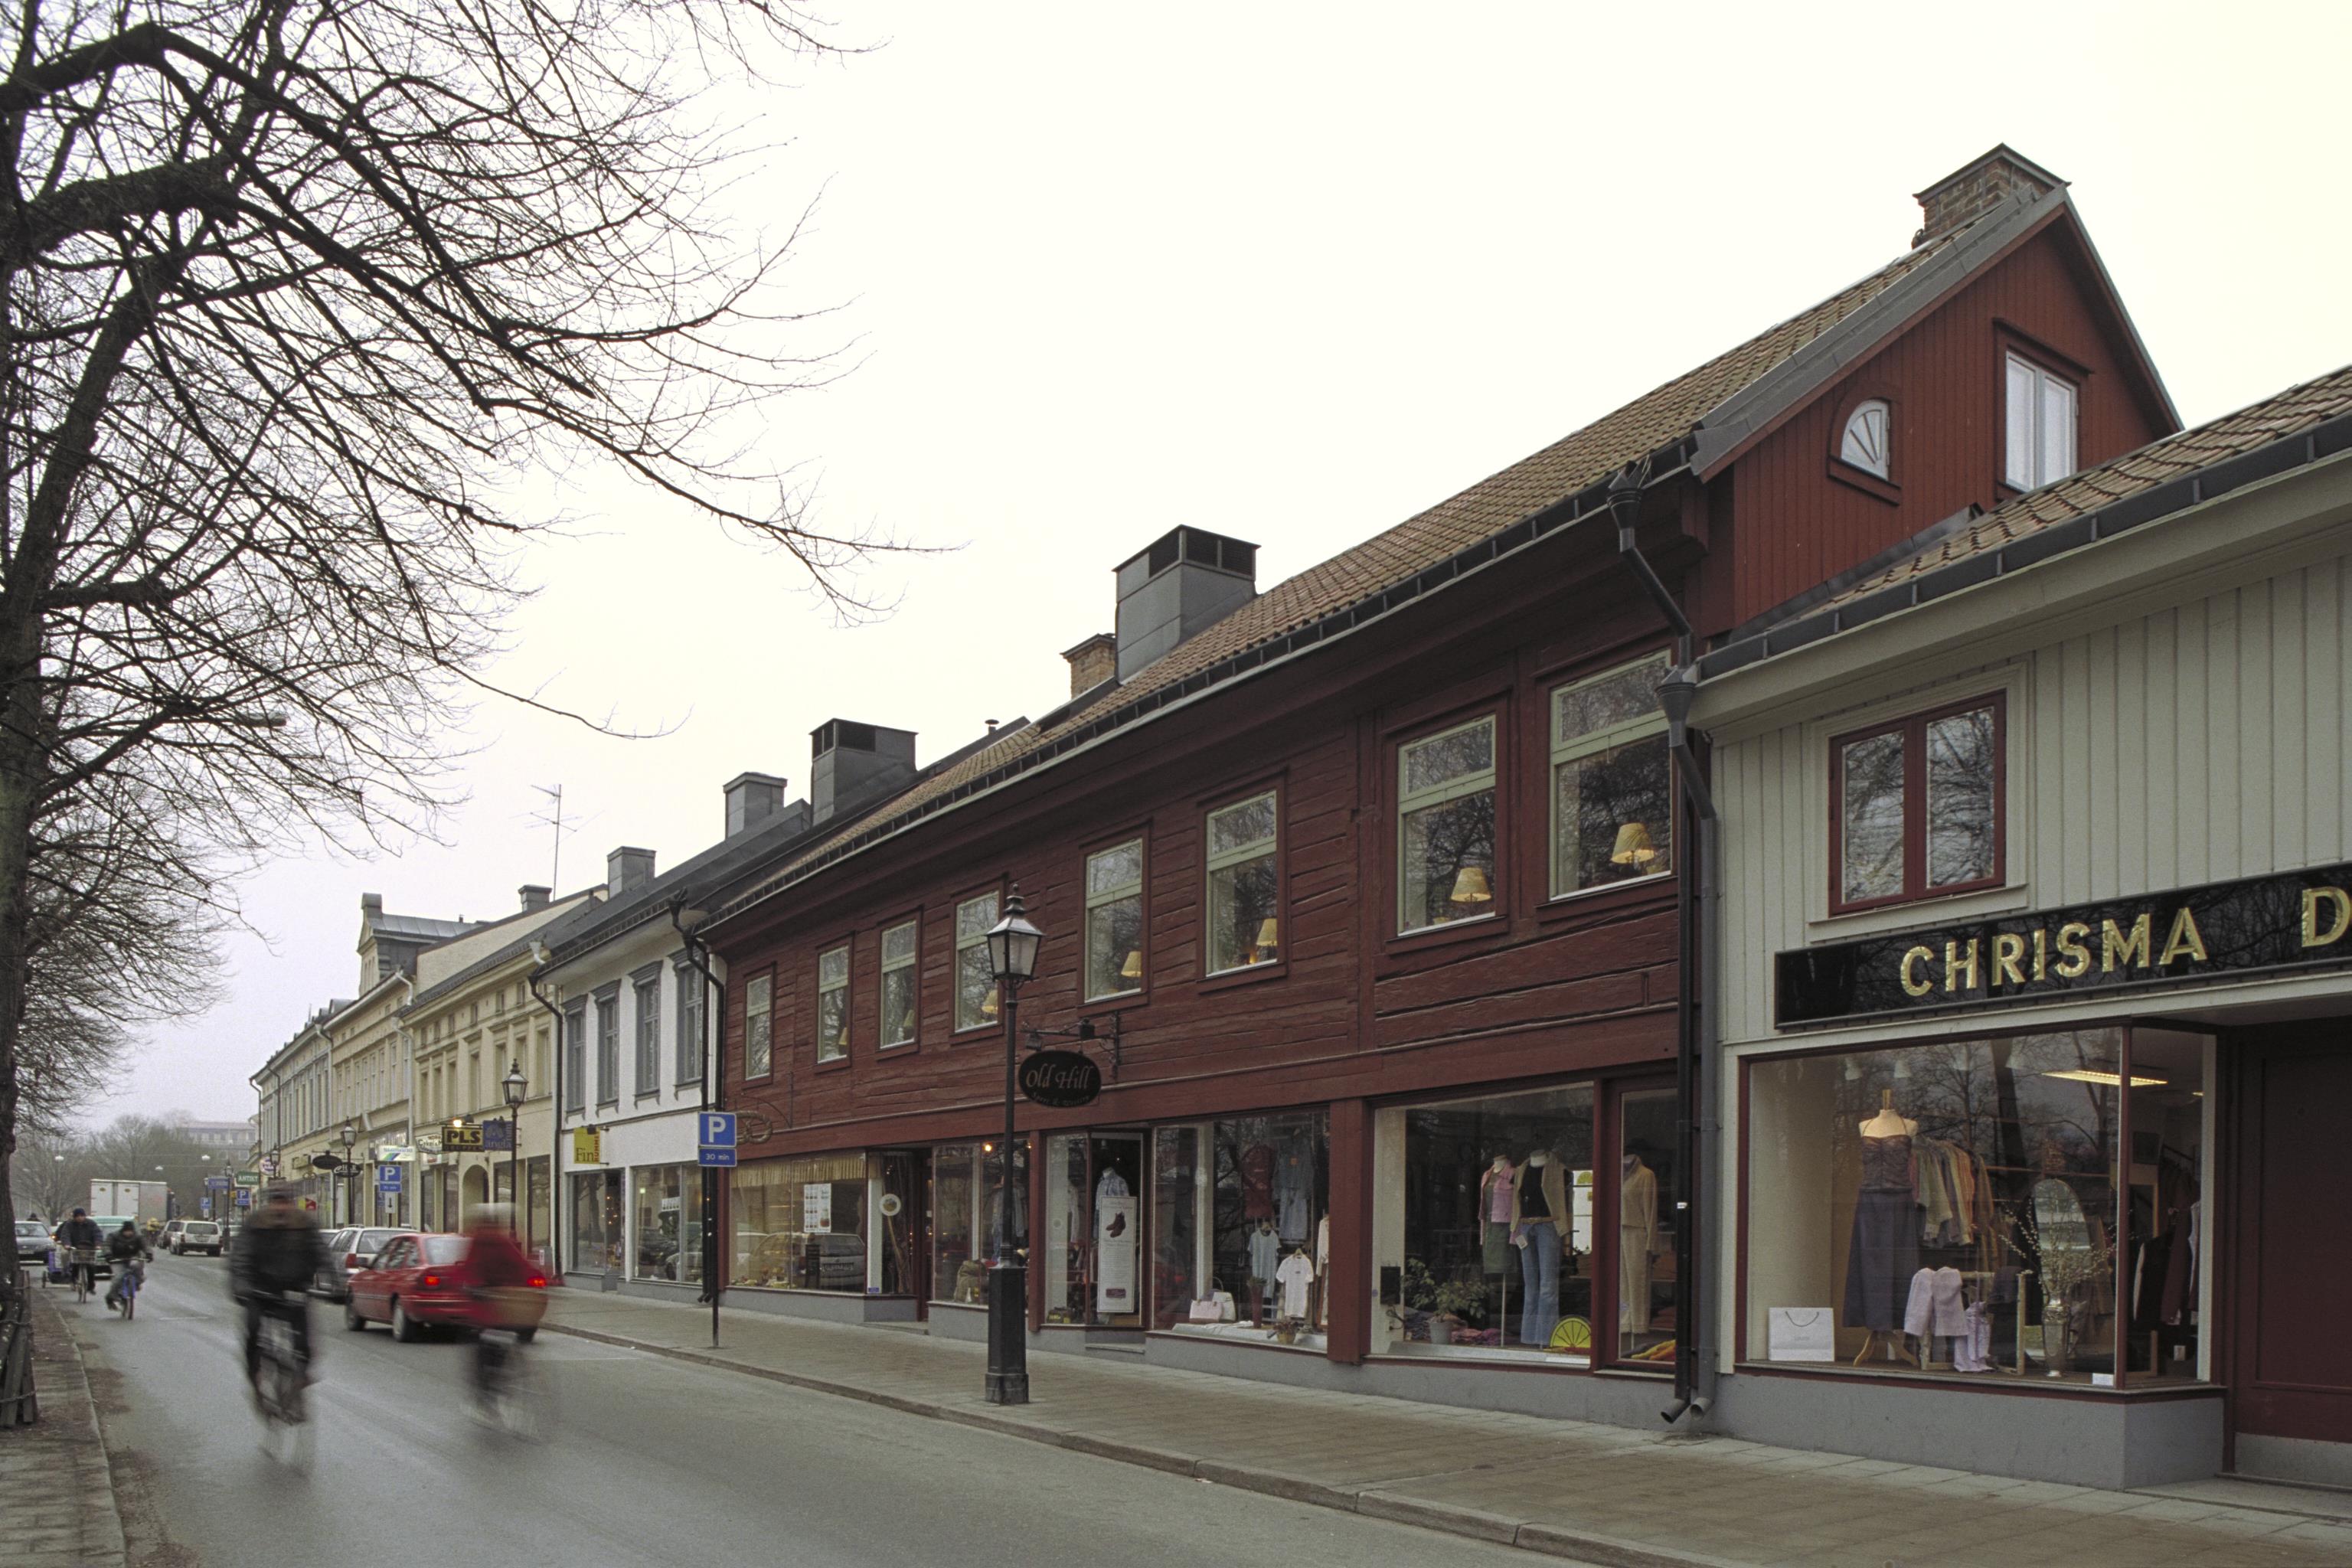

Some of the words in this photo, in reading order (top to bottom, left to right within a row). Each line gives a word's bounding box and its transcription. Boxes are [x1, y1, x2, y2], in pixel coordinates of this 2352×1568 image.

[1900, 906, 2208, 997] CHRISMA
[1026, 1063, 1056, 1087] Old
[1055, 1065, 1091, 1089] Hill
[446, 1130, 481, 1144] PLS
[709, 1116, 727, 1143] P
[576, 1147, 594, 1162] Fin
[384, 1167, 396, 1181] P
[240, 1190, 247, 1199] P
